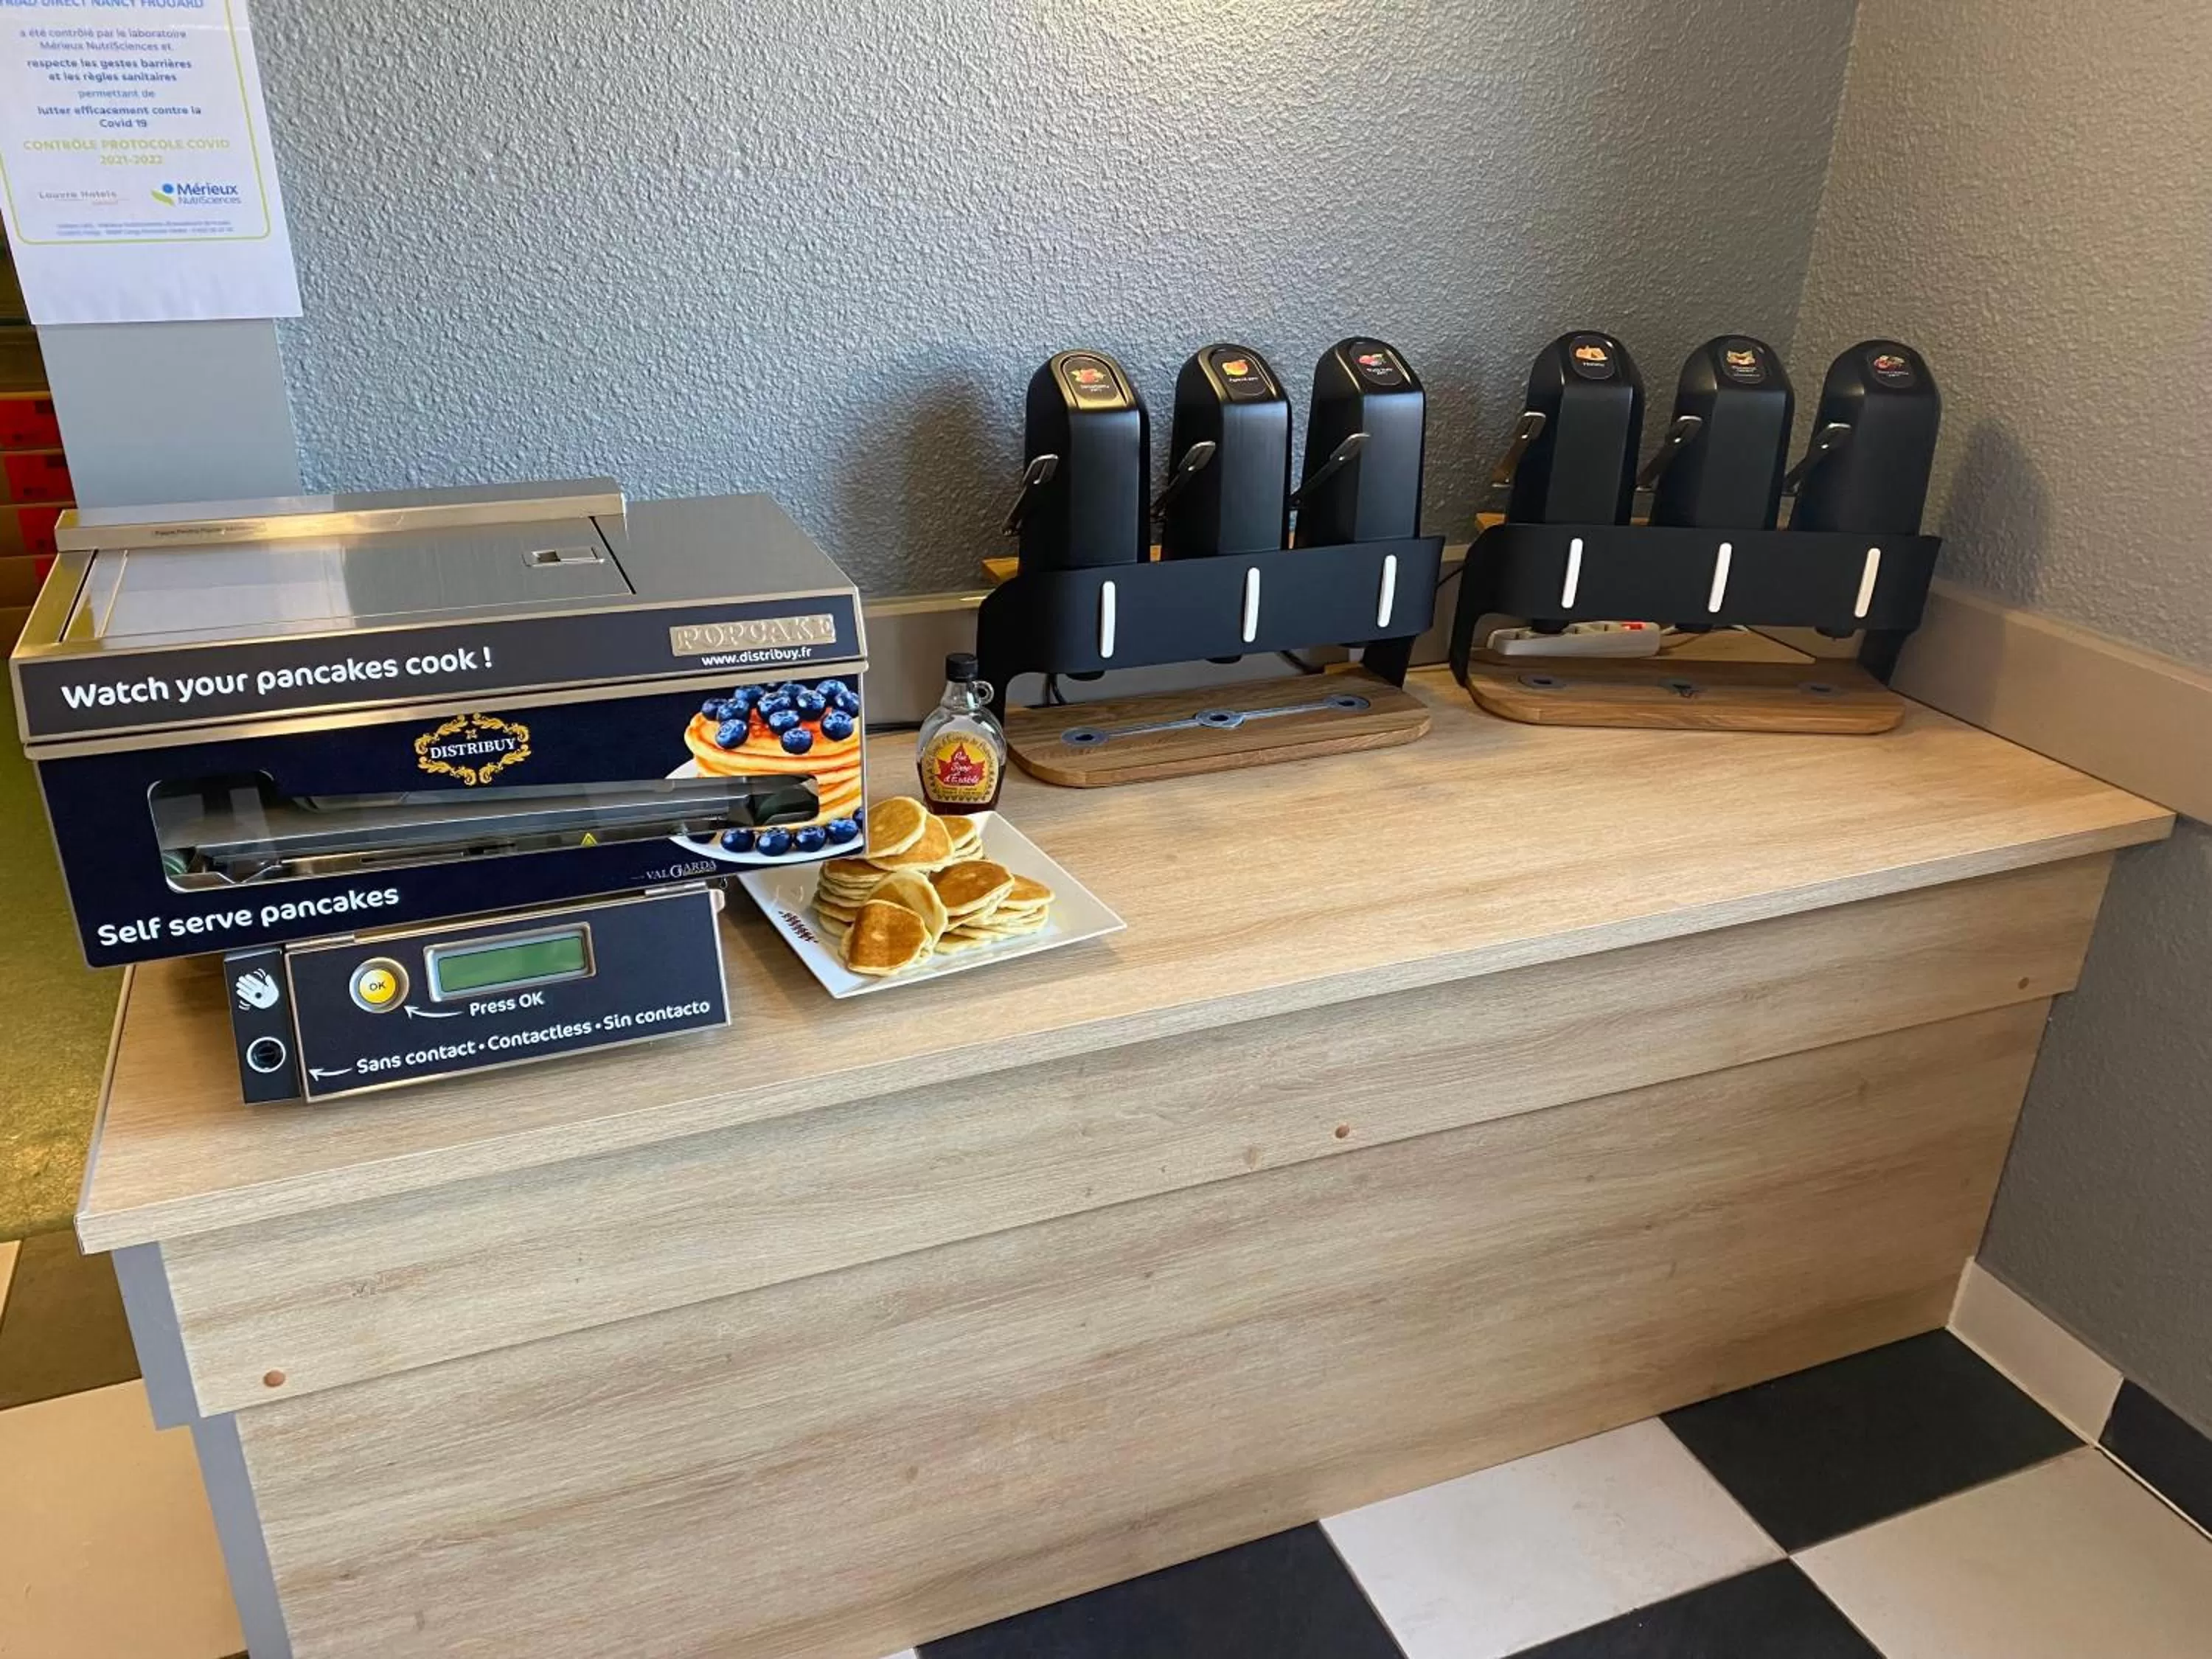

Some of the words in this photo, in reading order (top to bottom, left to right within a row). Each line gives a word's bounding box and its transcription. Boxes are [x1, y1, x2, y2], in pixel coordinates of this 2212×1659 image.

[97, 30, 114, 40] par
[116, 29, 127, 38] le
[129, 29, 187, 38] laboratoire
[39, 40, 83, 50] Mérieux
[86, 41, 159, 51] NutriSciences
[27, 59, 77, 70] respecte
[81, 59, 97, 68] les
[100, 60, 138, 69] gestes
[140, 58, 192, 69] barrières
[48, 73, 61, 81] et
[64, 72, 80, 81] les
[83, 72, 119, 83] règles
[122, 72, 177, 82] sanitaires
[77, 90, 138, 99] permettant
[142, 89, 155, 98] de
[38, 105, 71, 115] lutter
[74, 105, 148, 114] efficacement
[152, 106, 188, 114] contre
[191, 105, 202, 114] la
[99, 118, 133, 128] Covid
[136, 119, 147, 128] 19
[100, 139, 182, 150] PROTOCOLE
[187, 138, 230, 149] COVID
[100, 155, 163, 165] 2021-2022
[177, 183, 238, 195] Mérieux
[178, 196, 242, 205] NutriSciences
[677, 615, 833, 651] POPCAKE
[701, 646, 812, 667] www.distribuy.fr
[60, 674, 170, 709] Watch
[175, 672, 248, 703] your
[257, 655, 399, 695] pancakes
[405, 648, 477, 676] cook
[482, 646, 493, 667] !
[430, 737, 516, 759] DISTRIBUY
[98, 911, 161, 947] Self
[169, 905, 253, 936] serve
[261, 887, 400, 927] pancakes
[369, 980, 386, 990] OK
[469, 998, 515, 1017] Press
[518, 991, 544, 1008] OK
[356, 1055, 401, 1075] Sans
[406, 1040, 476, 1068] contact
[487, 1020, 592, 1051] Contactless
[603, 1012, 633, 1031] Sin
[635, 1000, 711, 1026] contacto
